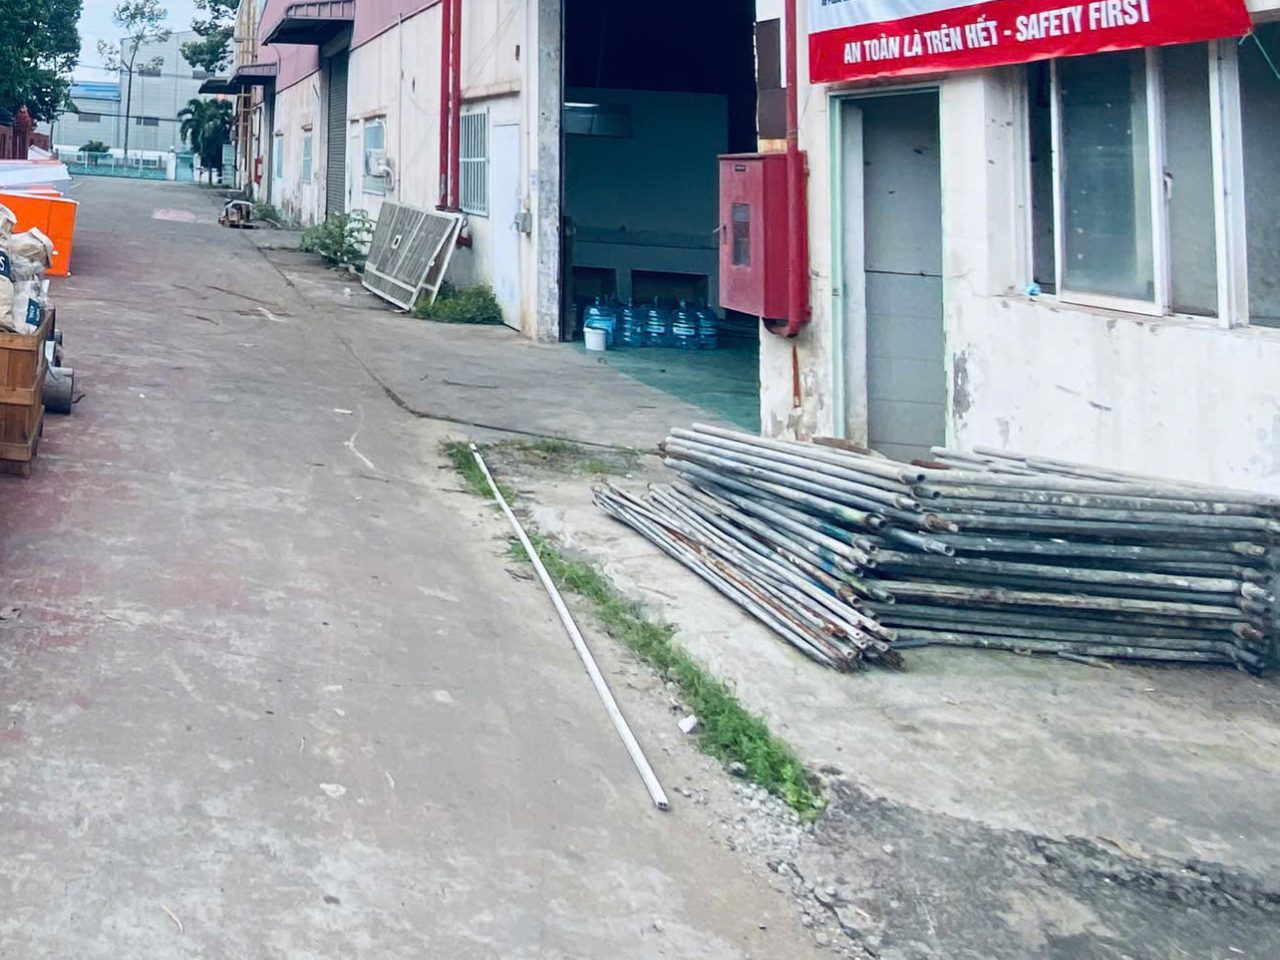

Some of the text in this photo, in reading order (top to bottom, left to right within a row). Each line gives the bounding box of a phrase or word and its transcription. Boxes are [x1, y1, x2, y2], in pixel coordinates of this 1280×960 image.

[844, 41, 861, 64] AN
[863, 32, 900, 61] TOÀN
[903, 28, 922, 57] LÀ
[924, 23, 963, 54] TRÊN
[965, 13, 998, 49] HẾT
[1016, 4, 1083, 42] SAFETY
